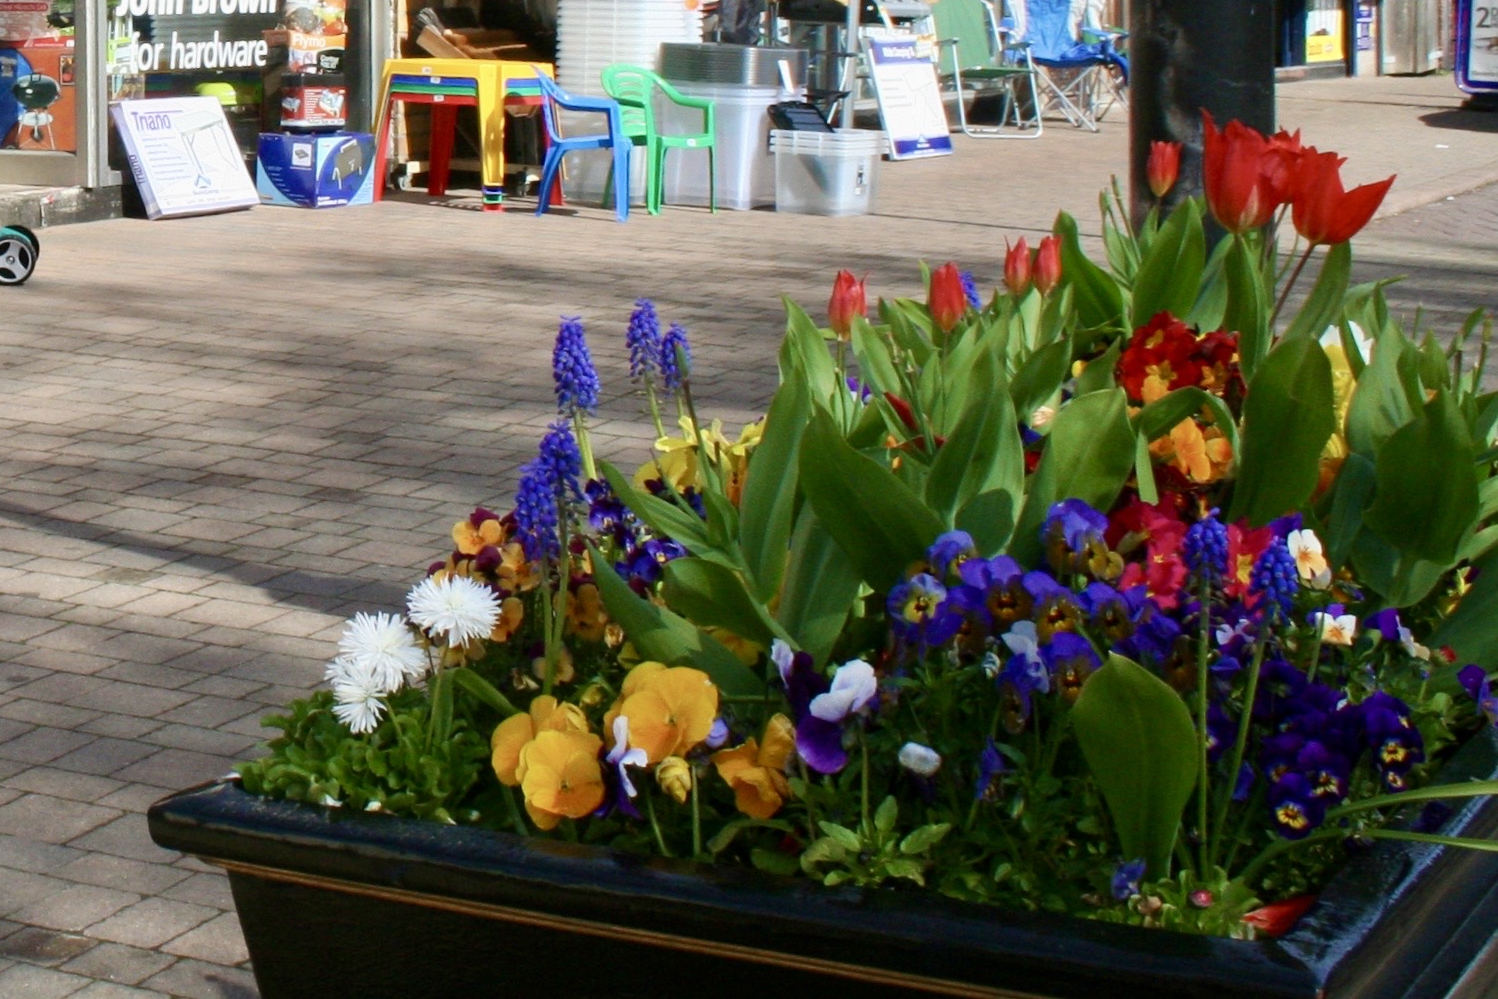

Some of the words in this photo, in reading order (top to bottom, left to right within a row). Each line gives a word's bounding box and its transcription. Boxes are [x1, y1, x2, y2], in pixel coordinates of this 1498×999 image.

[1475, 6, 1491, 28] 2
[131, 31, 166, 72] for
[170, 30, 268, 71] hardware
[294, 35, 325, 49] Flymo
[130, 111, 172, 132] Triano
